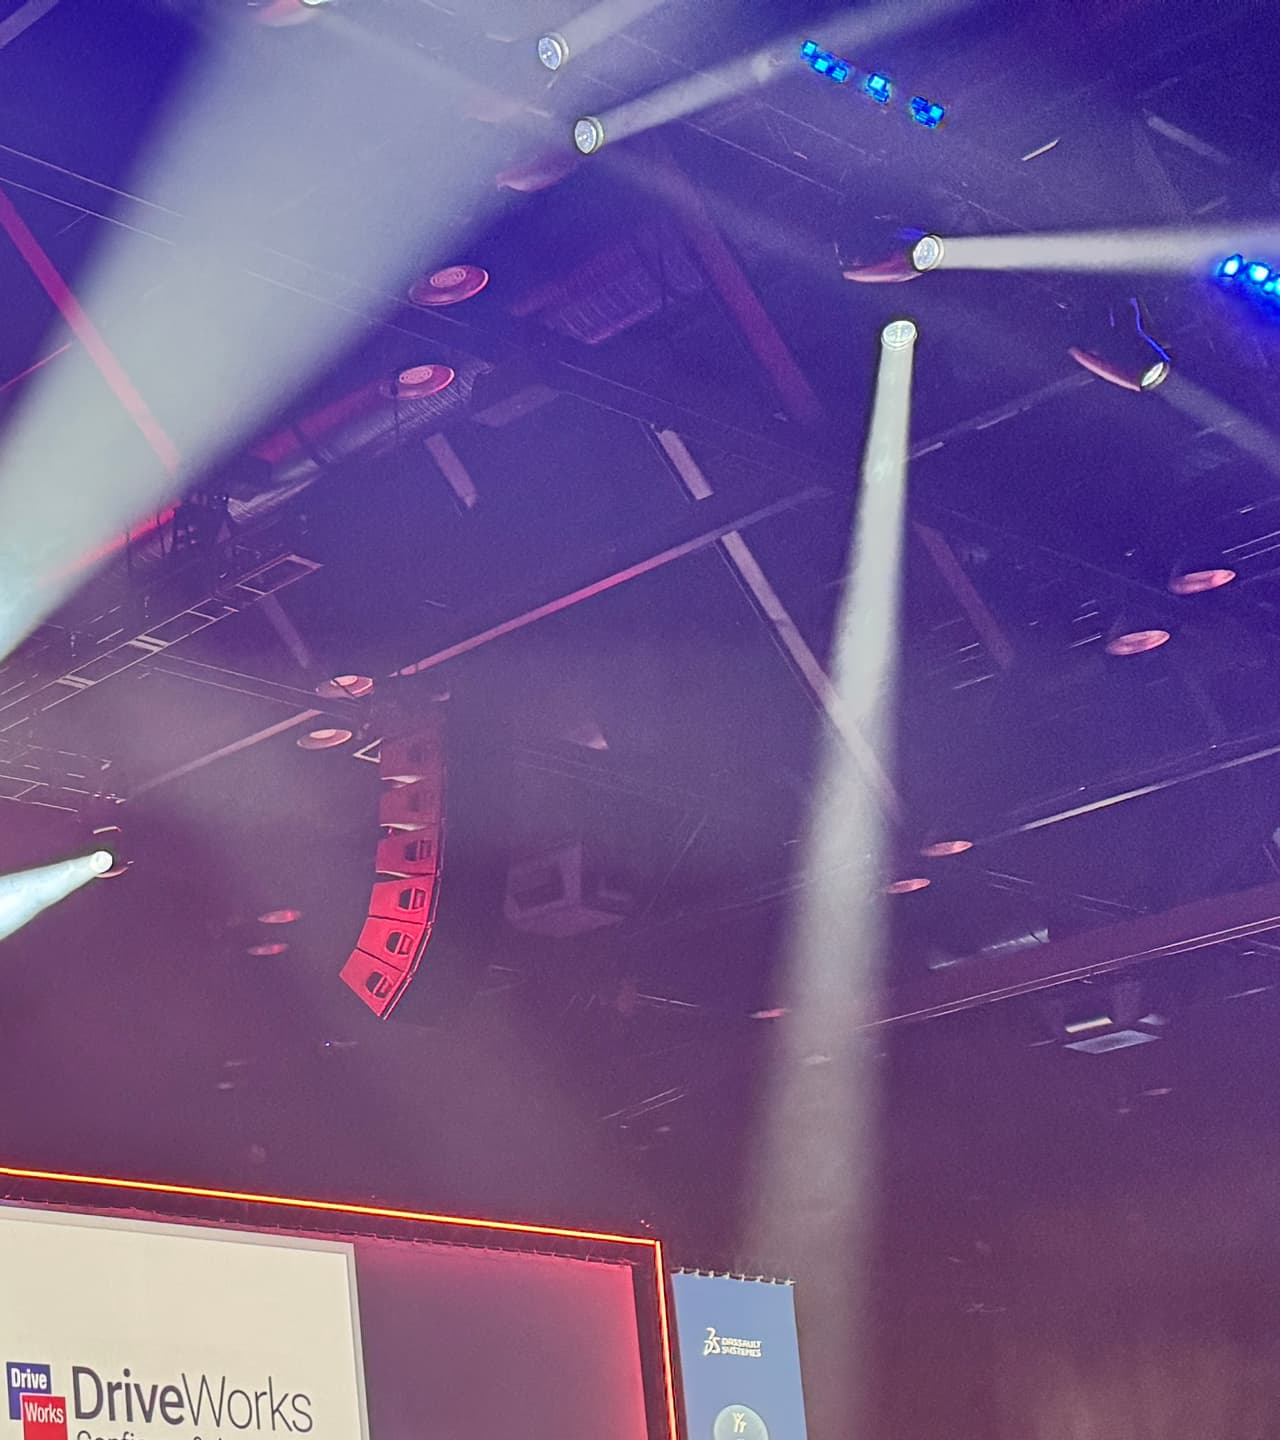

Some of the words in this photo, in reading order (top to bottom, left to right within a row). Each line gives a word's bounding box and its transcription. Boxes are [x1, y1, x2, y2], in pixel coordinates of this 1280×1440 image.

[11, 1367, 48, 1390] Drive
[71, 1365, 314, 1433] DriveWorks
[24, 1401, 65, 1425] Works
